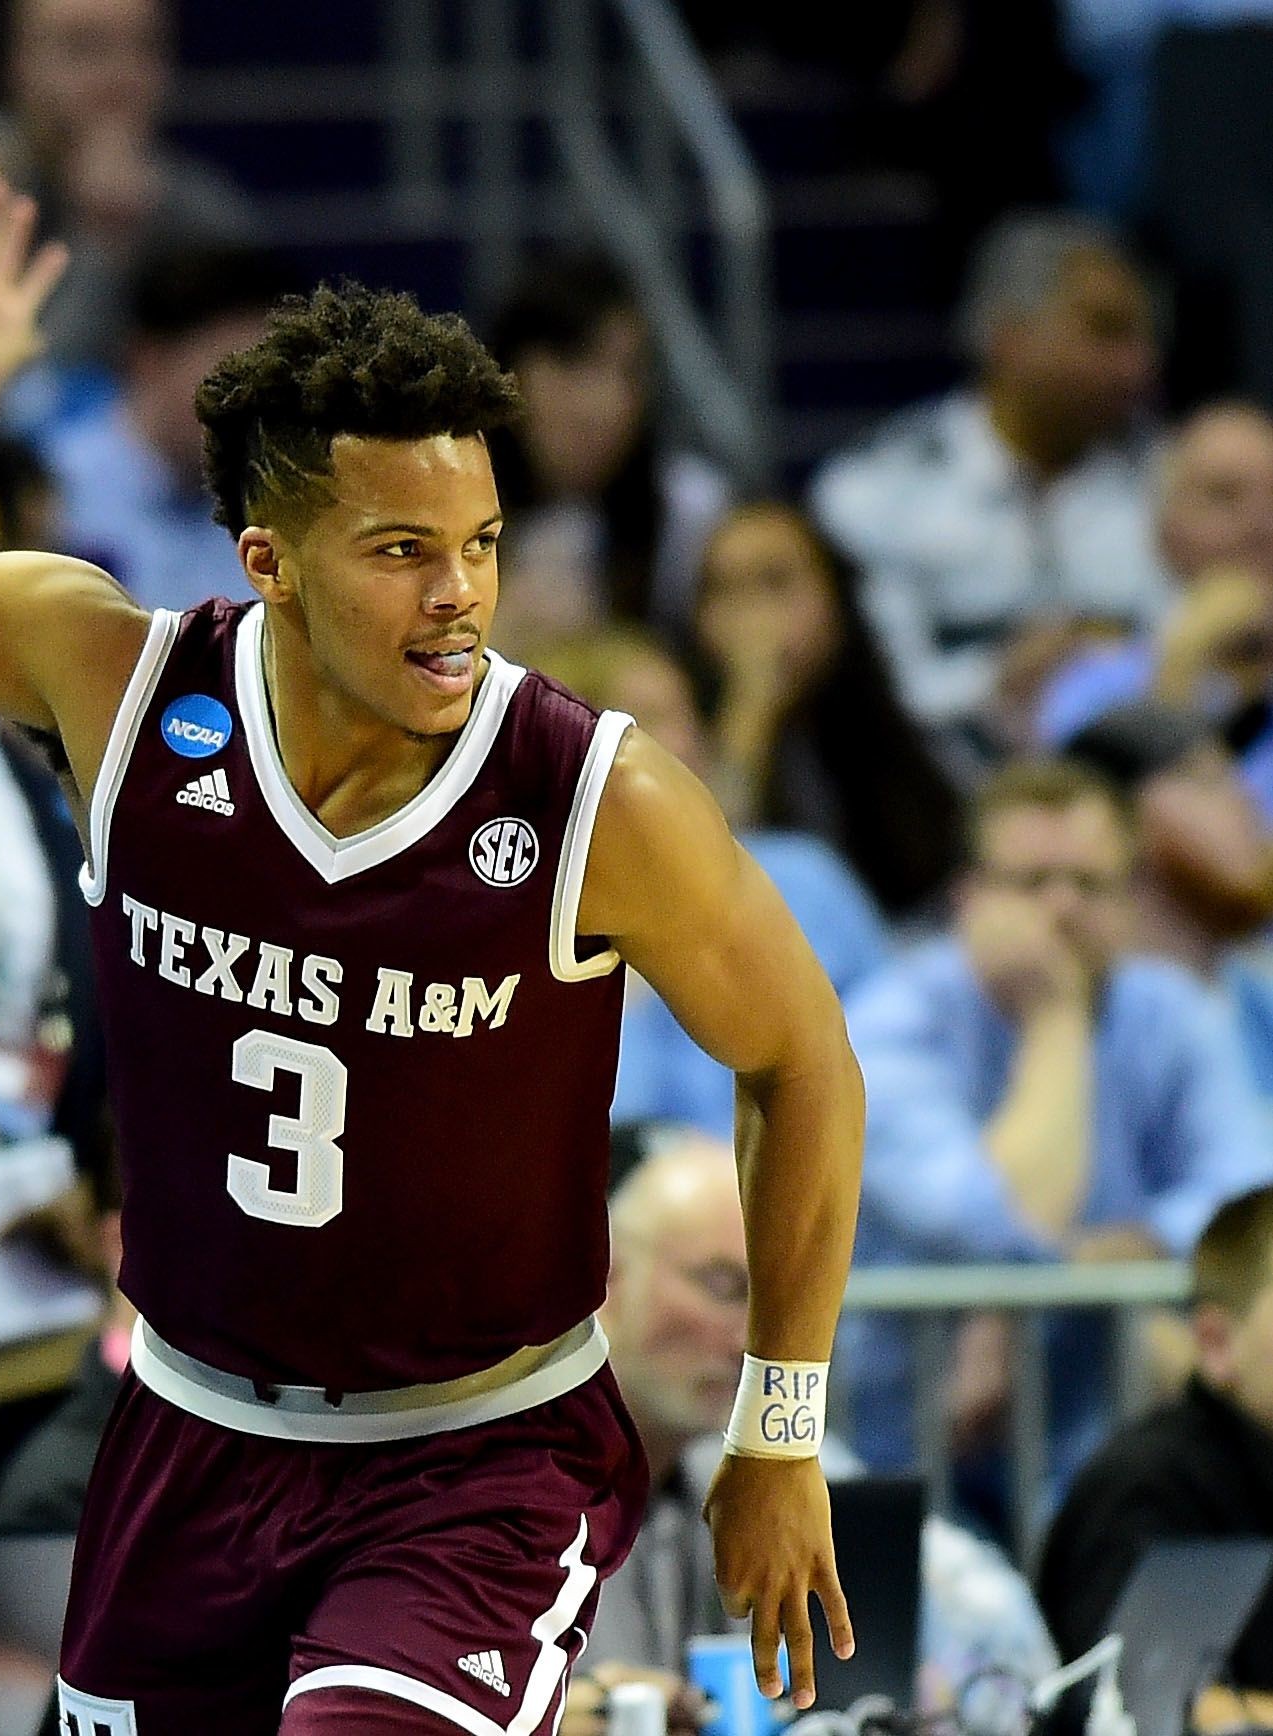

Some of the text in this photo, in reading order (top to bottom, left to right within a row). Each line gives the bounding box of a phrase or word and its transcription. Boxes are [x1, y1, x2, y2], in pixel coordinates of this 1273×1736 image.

[167, 718, 225, 748] NCAA
[176, 790, 235, 816] adidas
[475, 822, 533, 881] SEC
[122, 893, 521, 1038] TEXAS A&M
[227, 1028, 348, 1228] 3
[764, 1366, 819, 1400] RIP
[457, 1657, 511, 1697] adidas
